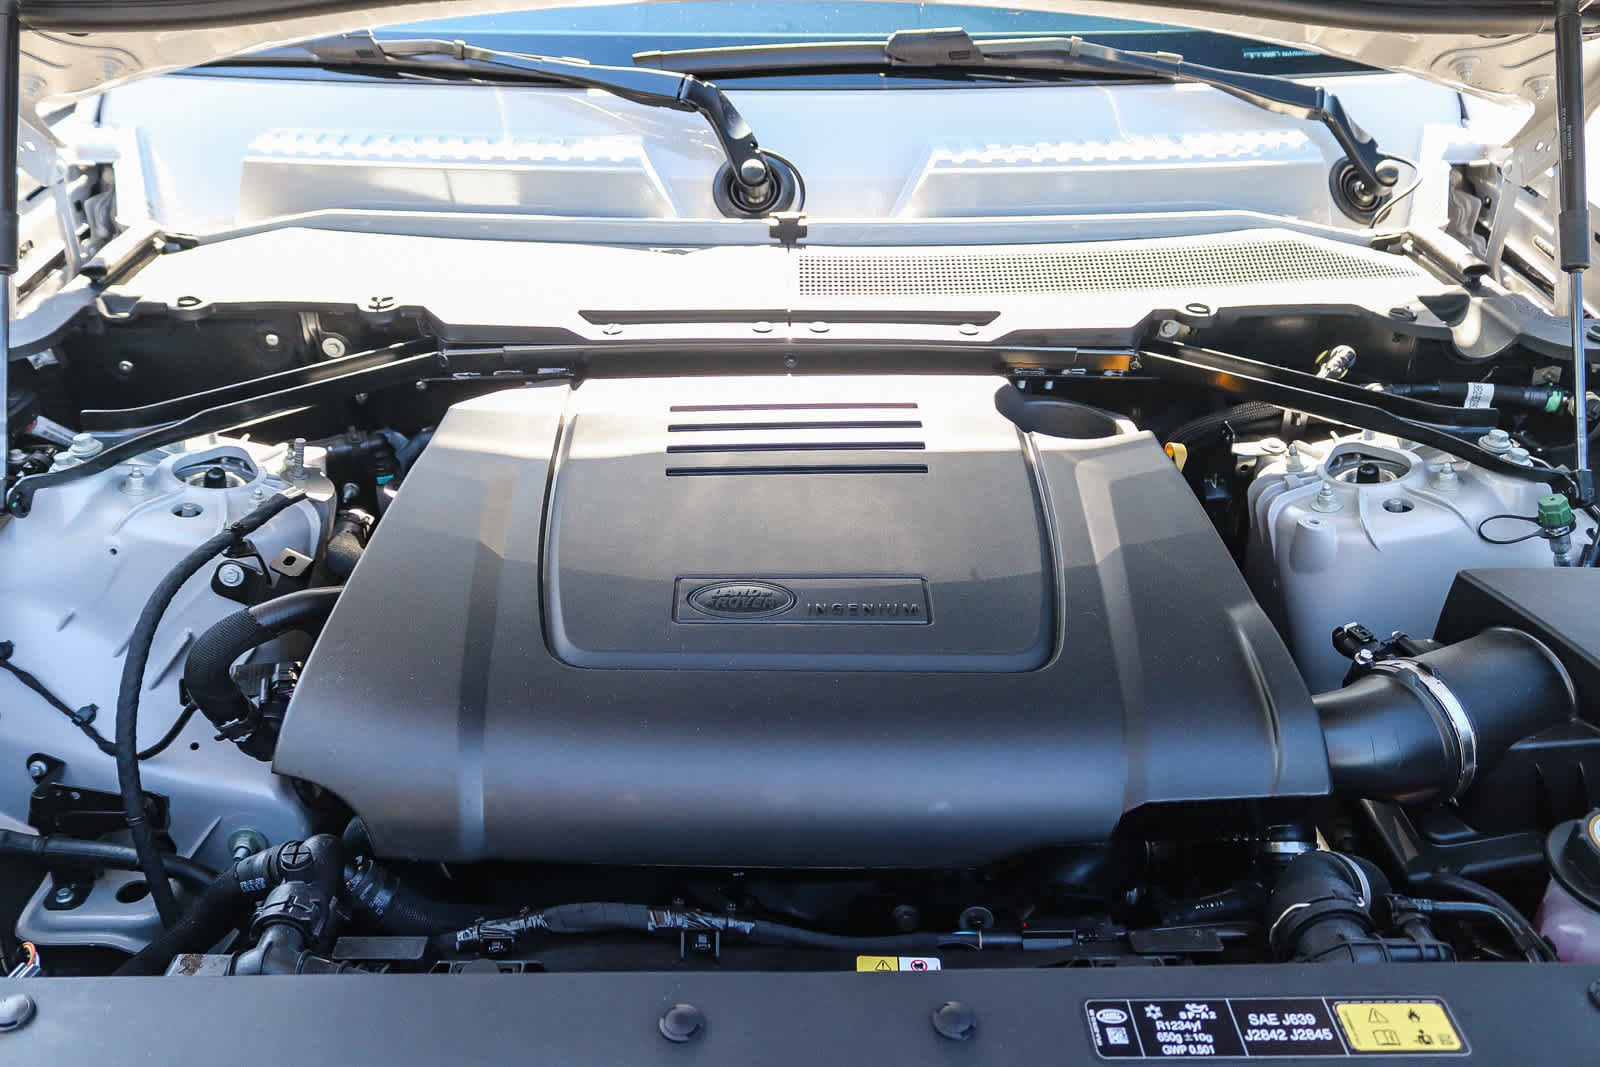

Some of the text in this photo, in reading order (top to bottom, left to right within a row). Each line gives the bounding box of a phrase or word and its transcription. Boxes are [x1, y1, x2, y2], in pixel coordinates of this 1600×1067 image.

[807, 602, 920, 617] INGENIUM
[1247, 1013, 1316, 1026] SAE J639
[1156, 1032, 1183, 1044] 650g
[1244, 1028, 1333, 1041] J2842 J2845
[1161, 1045, 1187, 1055] GWP
